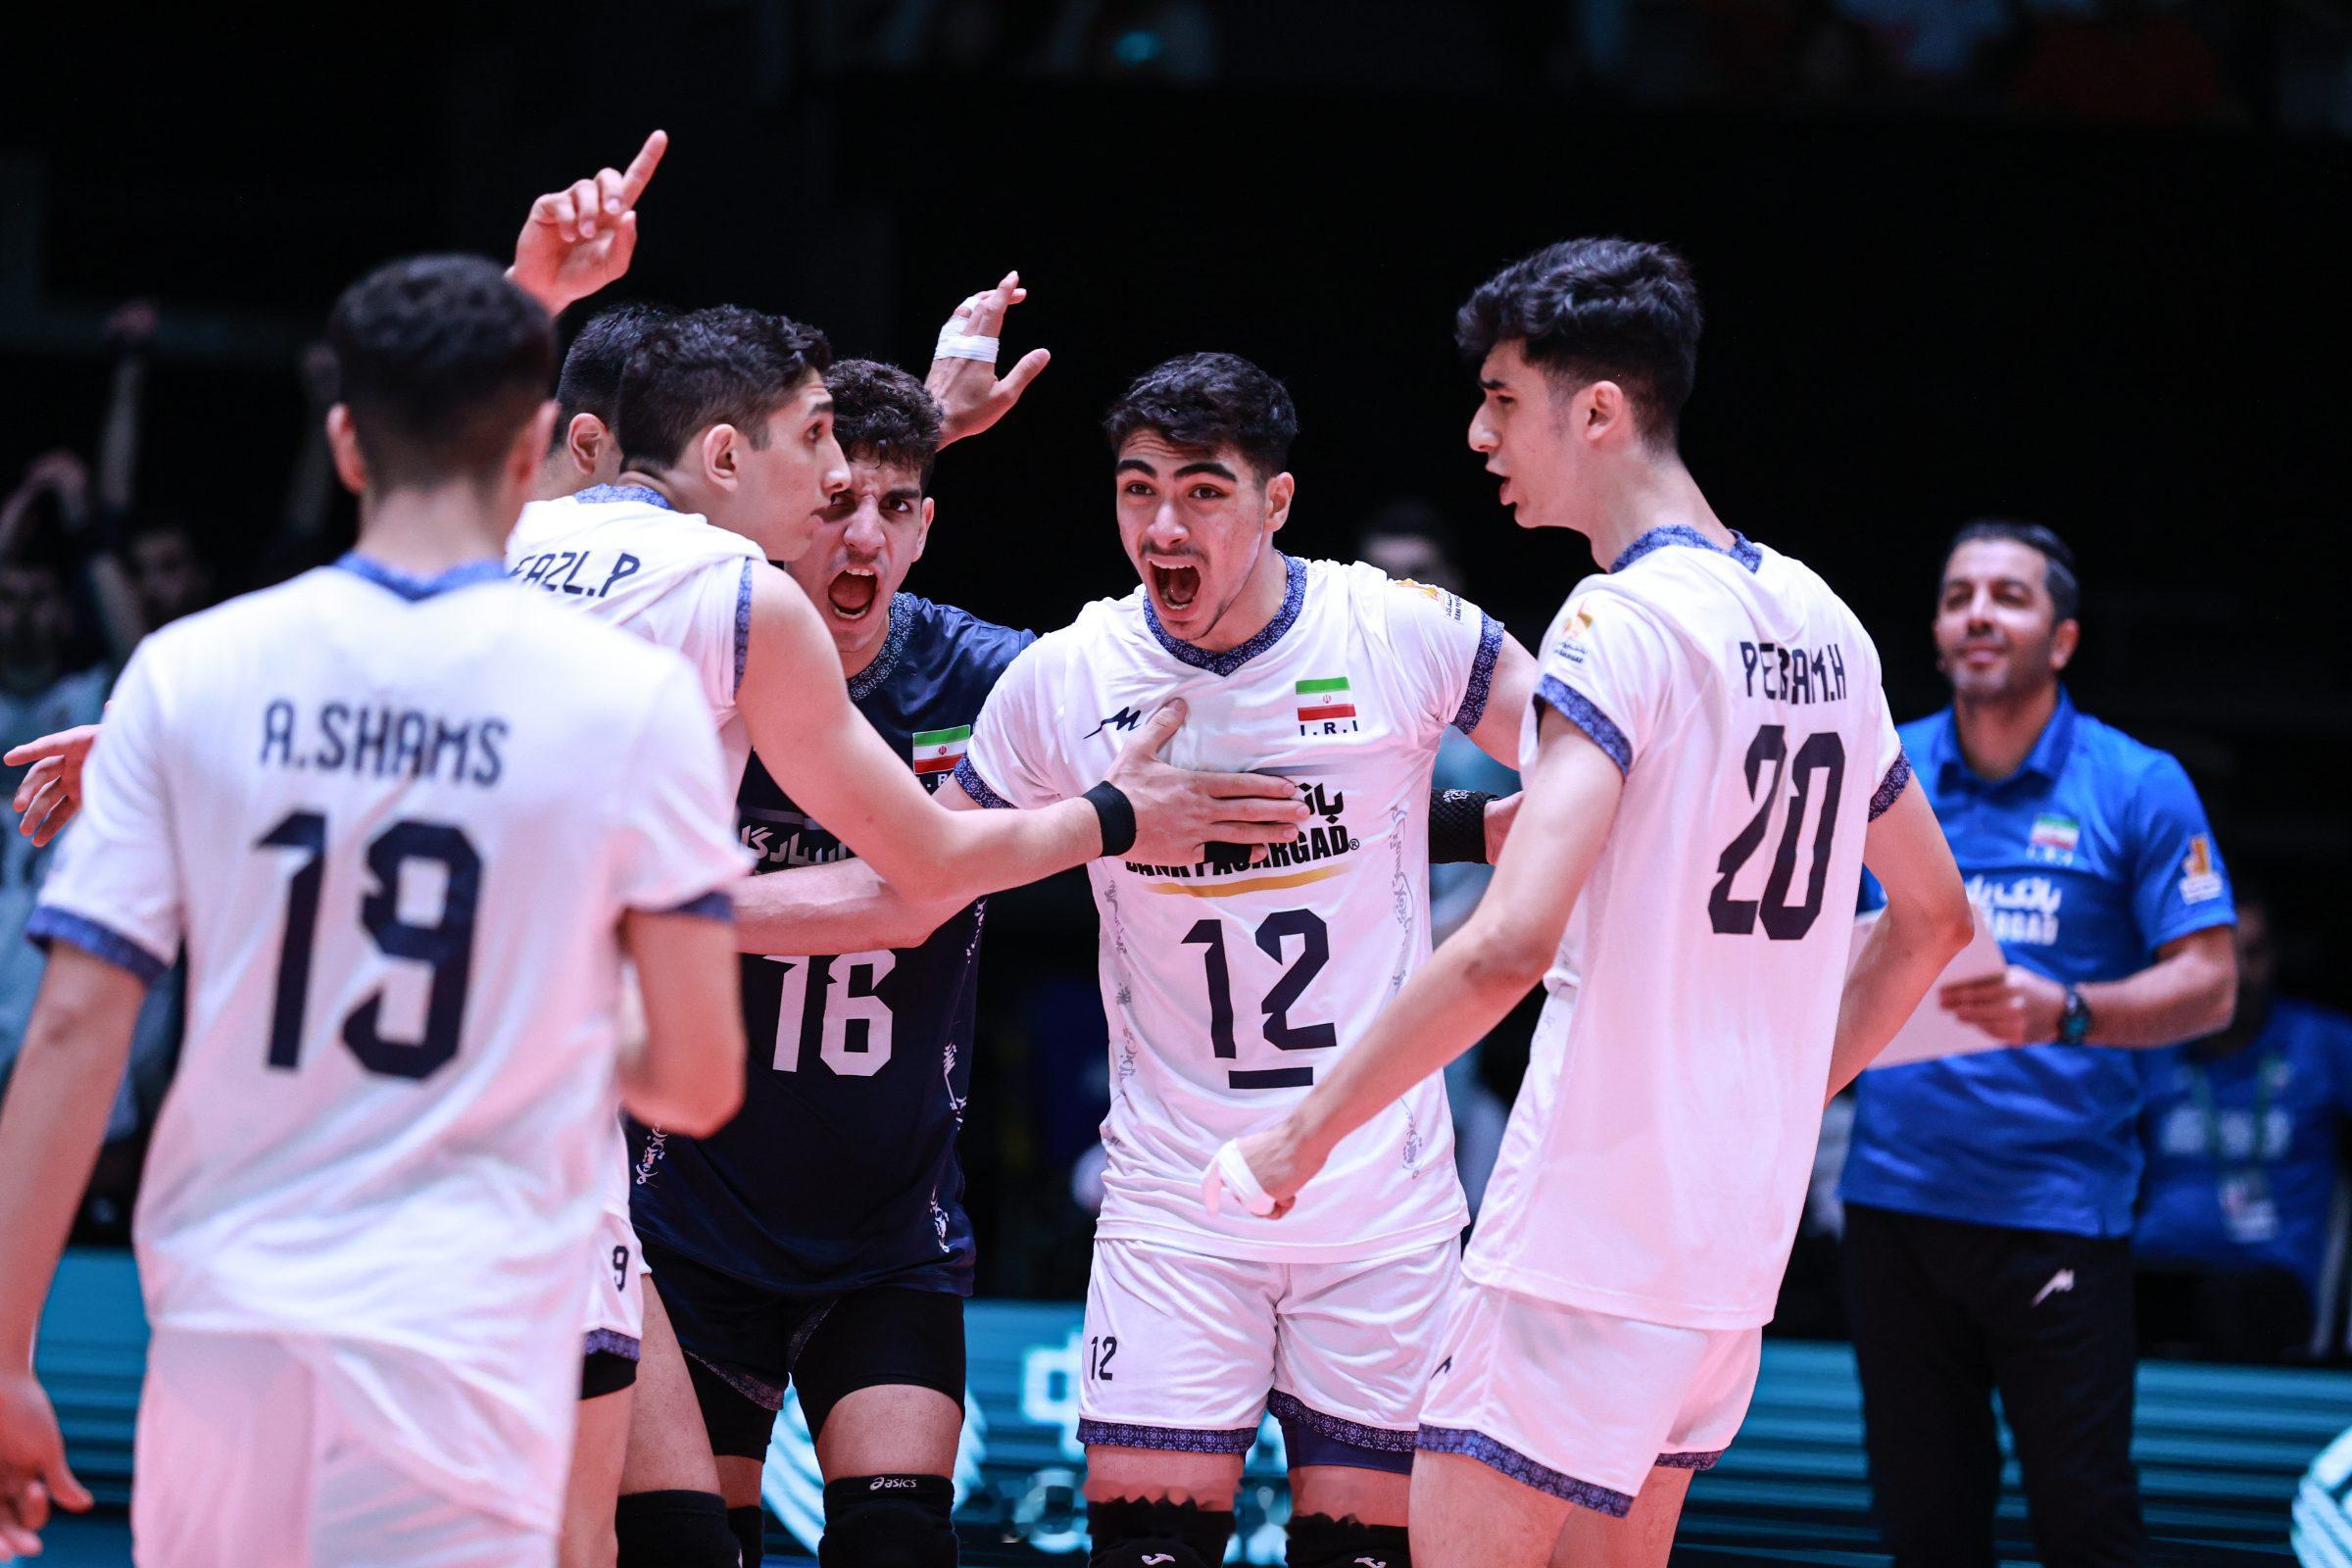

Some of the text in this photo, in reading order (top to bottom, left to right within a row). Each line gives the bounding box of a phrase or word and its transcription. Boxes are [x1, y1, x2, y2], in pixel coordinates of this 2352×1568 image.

[261, 699, 510, 786] A.SHAMS
[1707, 724, 1845, 941] 20
[253, 810, 482, 1080] 19
[1181, 907, 1338, 1059] 12
[761, 948, 897, 1077] 16
[612, 1245, 630, 1292] 9
[1091, 1336, 1117, 1381] 12
